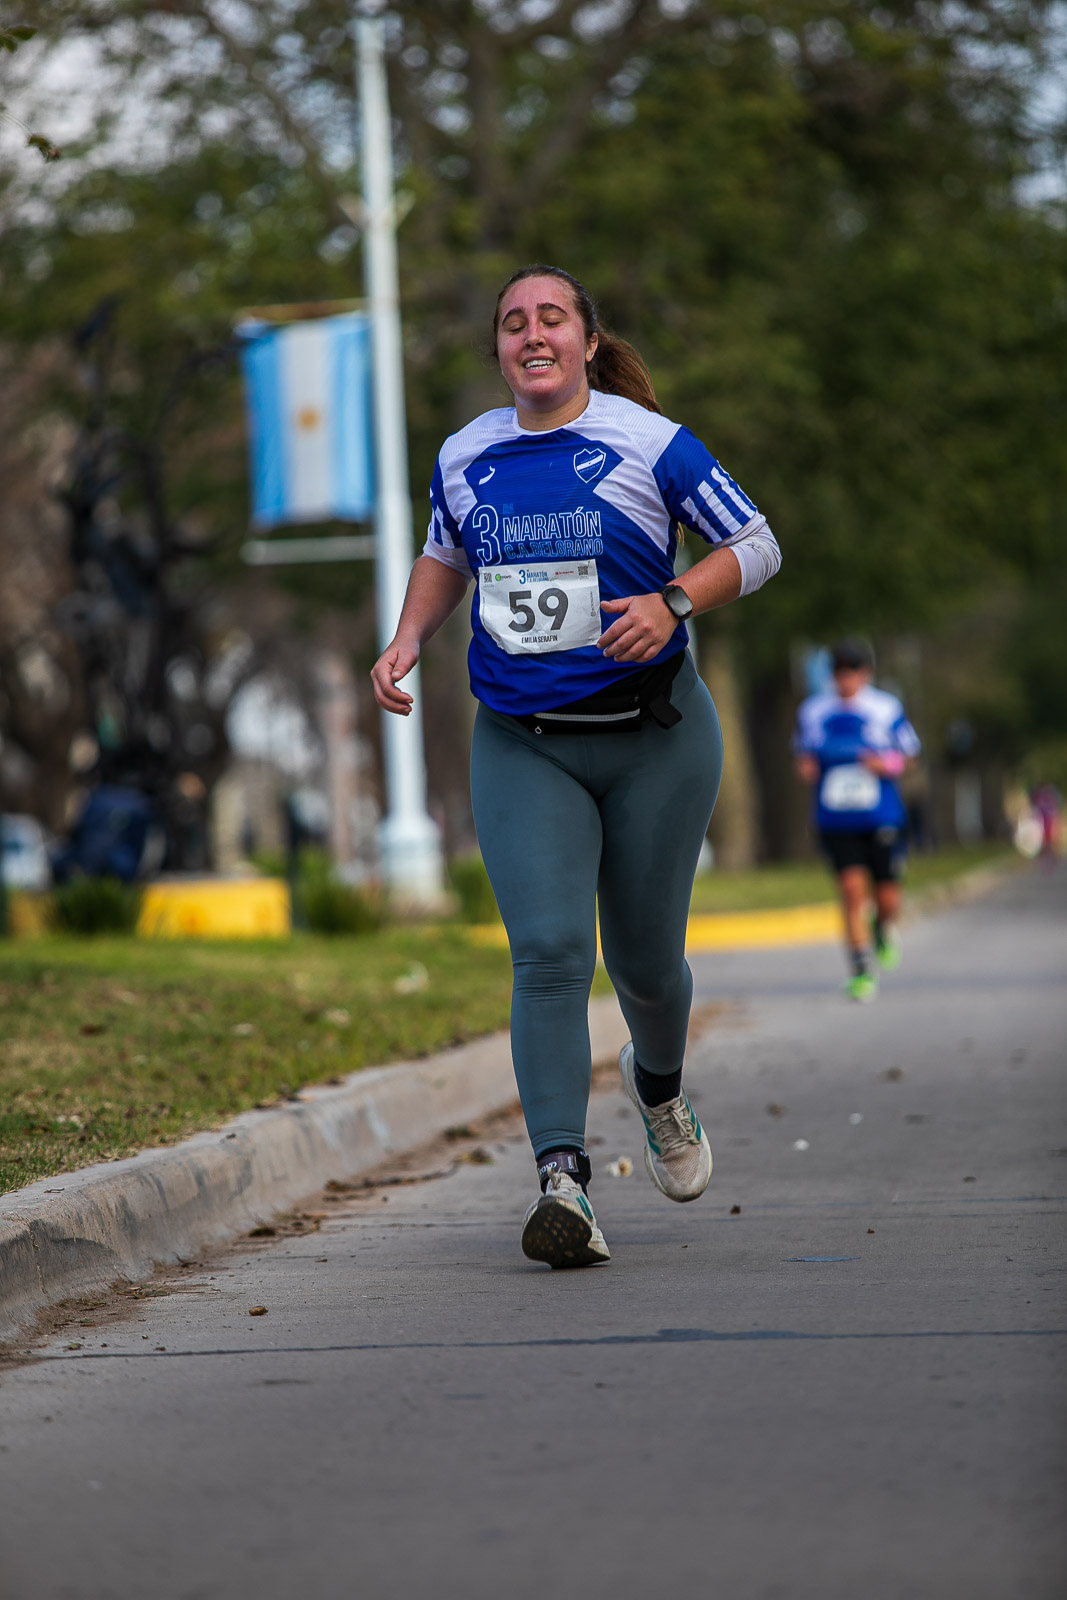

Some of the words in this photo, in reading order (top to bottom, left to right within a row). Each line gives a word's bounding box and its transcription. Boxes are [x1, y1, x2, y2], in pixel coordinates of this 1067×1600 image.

[472, 504, 502, 568] 3
[502, 506, 602, 543] MARATÓN
[518, 569, 527, 585] 3
[508, 587, 569, 633] 59
[521, 636, 538, 644] EMILIA
[538, 634, 558, 643] SERAFIN
